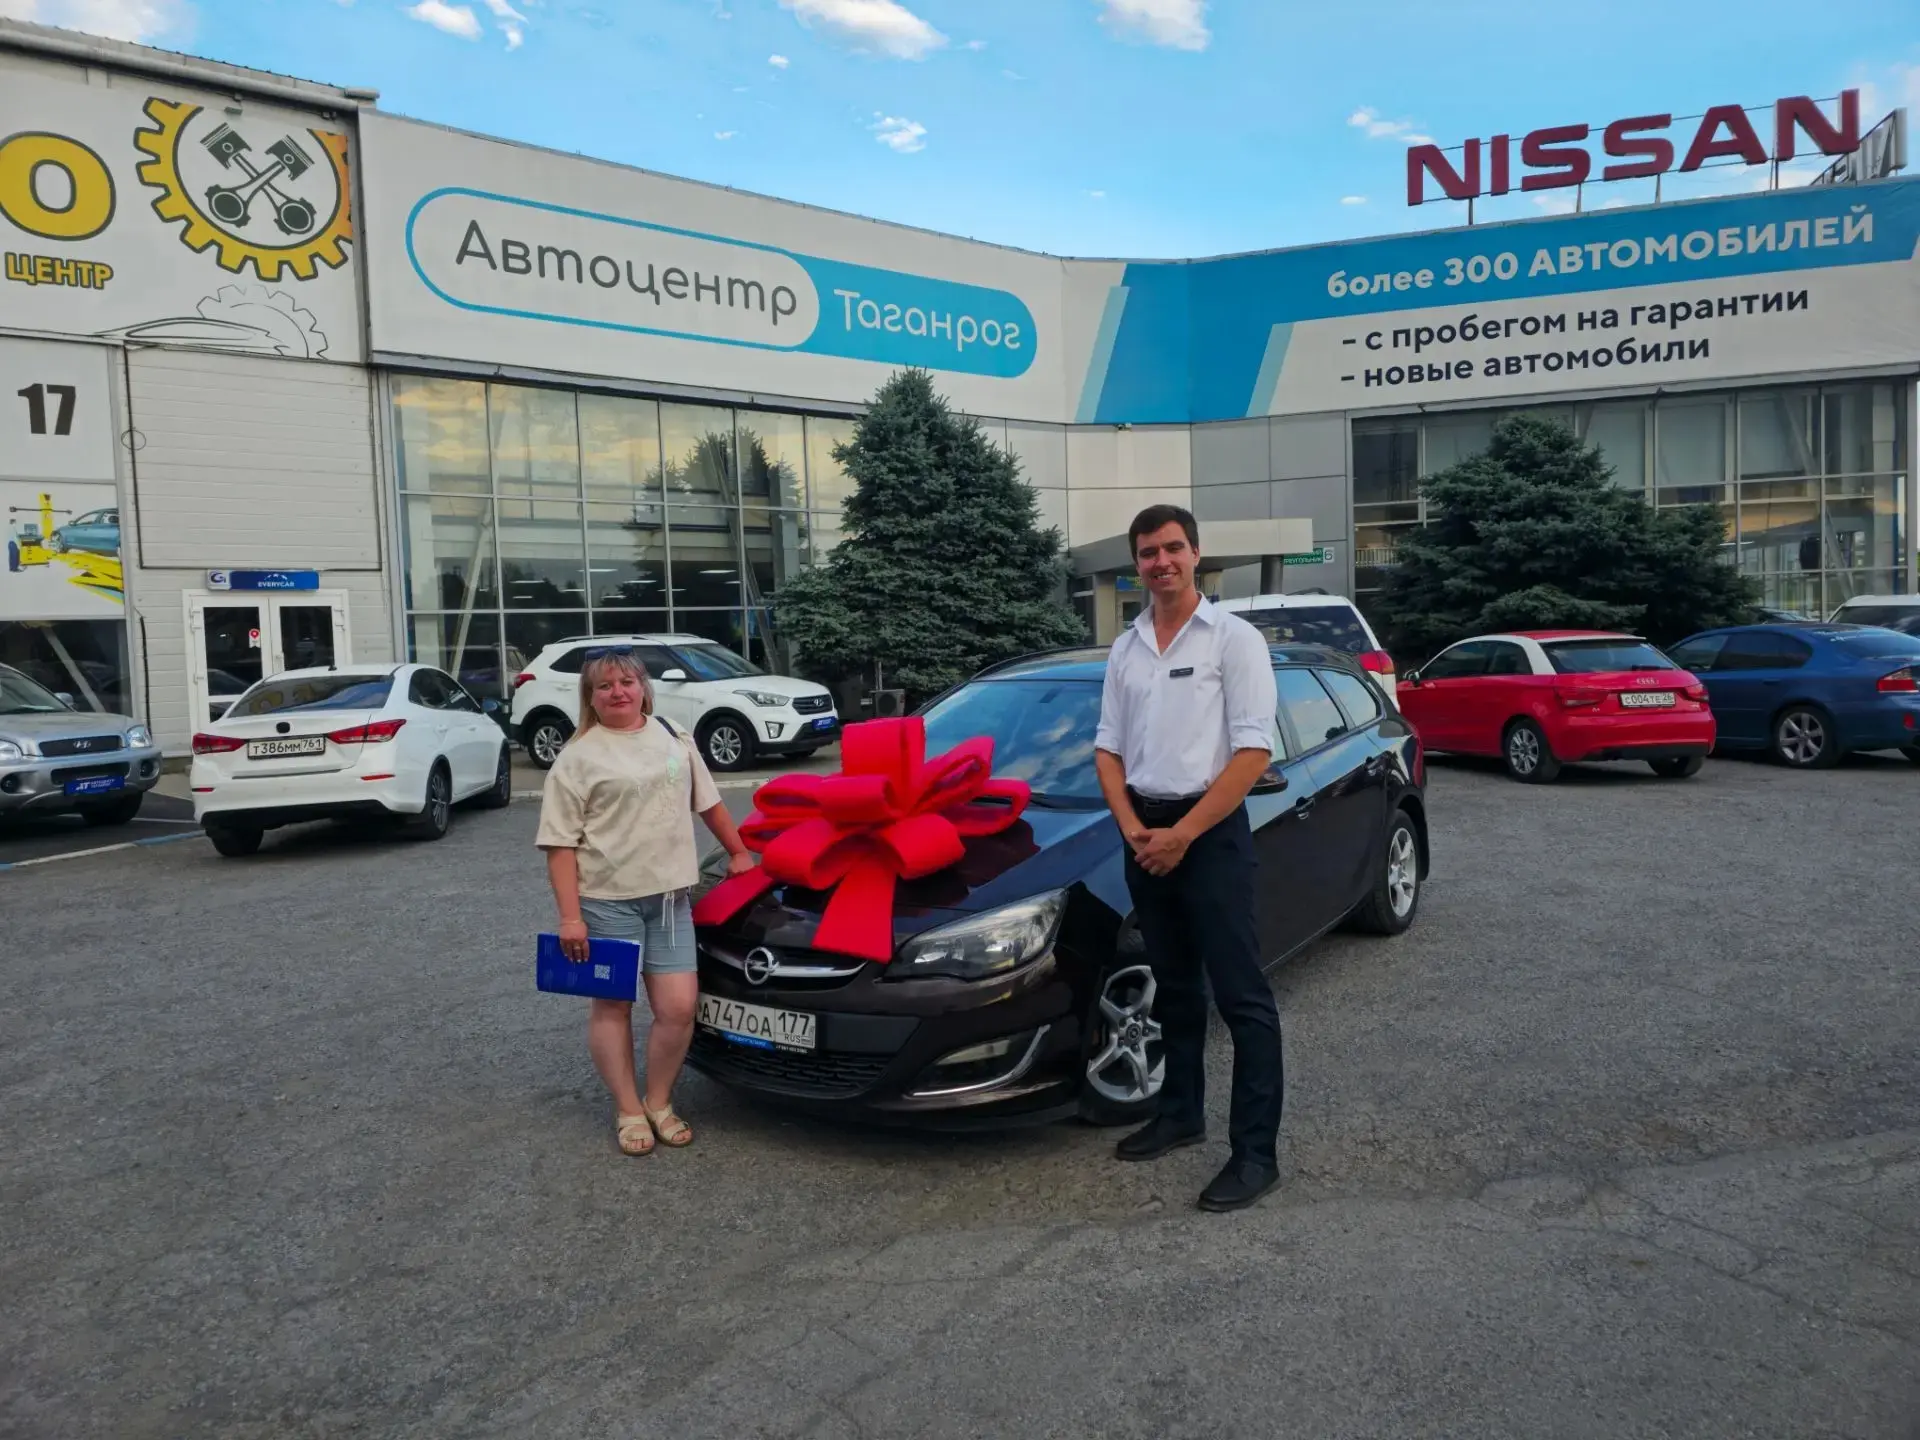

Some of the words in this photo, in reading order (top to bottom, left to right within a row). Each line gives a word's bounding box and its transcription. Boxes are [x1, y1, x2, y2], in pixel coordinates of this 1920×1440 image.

[1407, 88, 1860, 207] NISSAN
[4, 252, 114, 290] ЦЕНТР
[1327, 268, 1434, 298] более
[1444, 254, 1519, 285] 300
[1530, 204, 1874, 277] АВТОМОБИЛЕЙ
[455, 219, 798, 325] Автоцентр
[833, 288, 1021, 352] Таганрог
[1365, 331, 1383, 350] с
[1393, 312, 1567, 352] пробегом
[1578, 308, 1619, 331] на
[1631, 288, 1809, 329] гарантии
[1365, 362, 1474, 388] новые
[1484, 335, 1711, 377] автомобили
[17, 383, 77, 436] 17
[1325, 550, 1333, 560] 6
[784, 1034, 801, 1044] RUS
